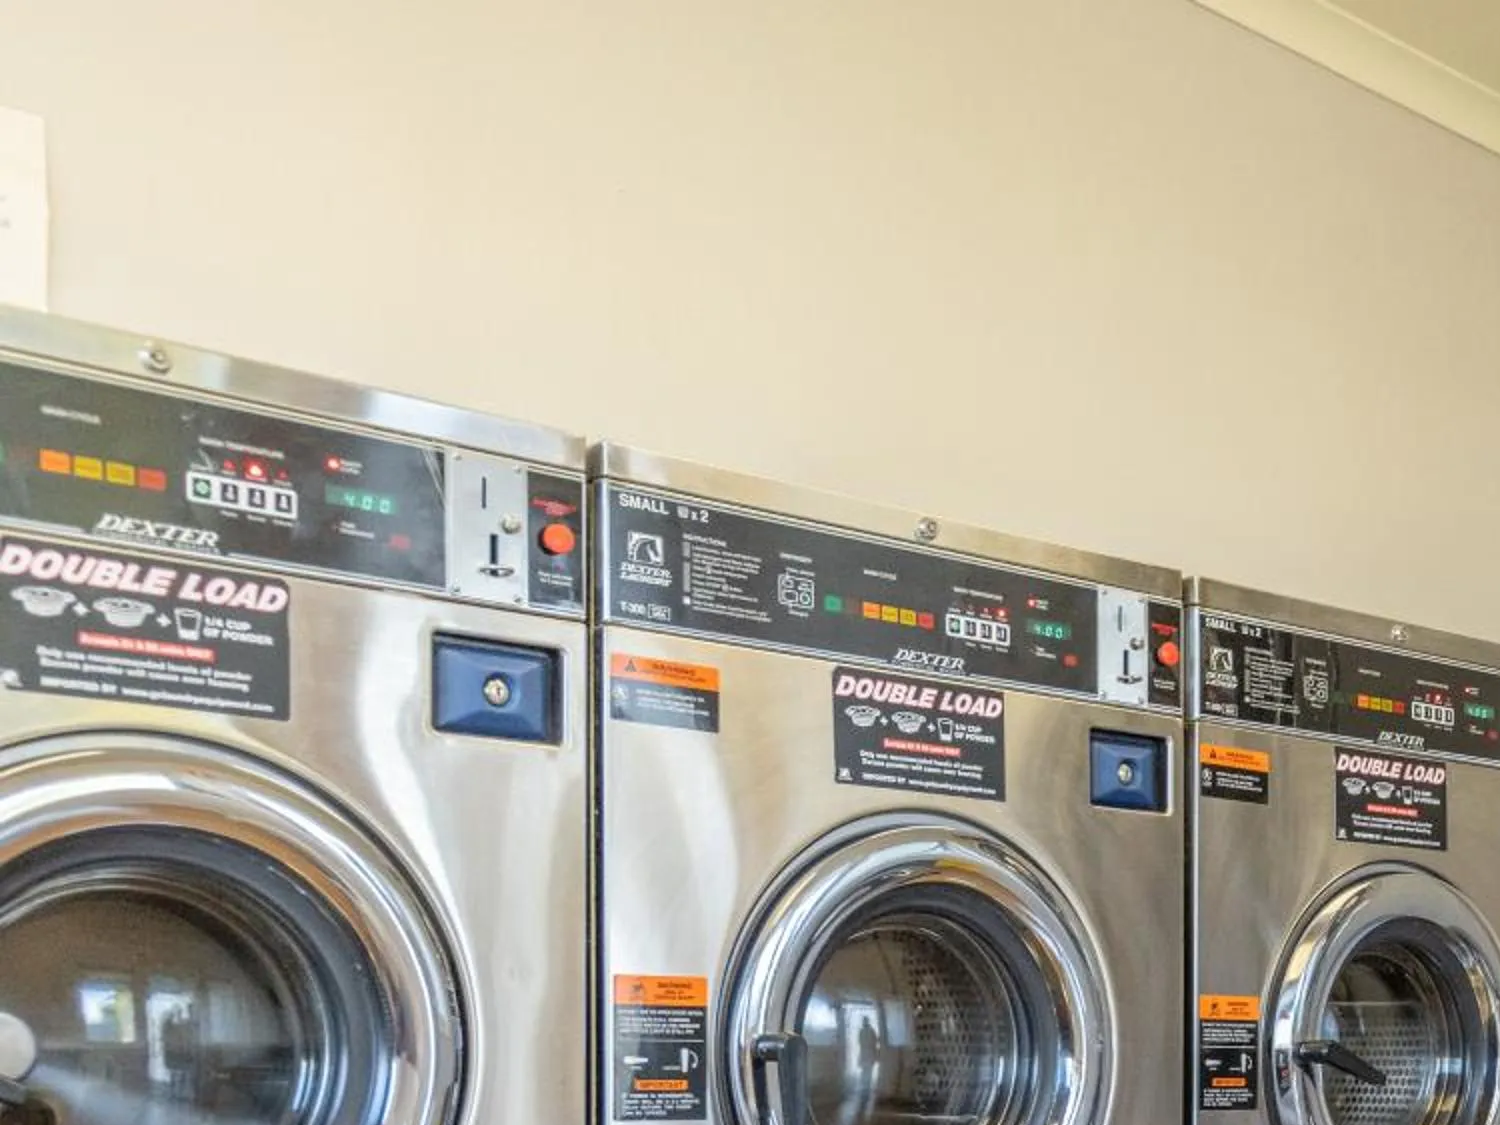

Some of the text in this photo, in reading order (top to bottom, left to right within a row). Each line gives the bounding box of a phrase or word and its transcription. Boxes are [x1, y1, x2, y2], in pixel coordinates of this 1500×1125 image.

[618, 493, 670, 517] SMALL
[700, 508, 710, 523] 2
[95, 512, 221, 547] DEXTER
[0, 544, 290, 614] DOUBLE LOAD
[1205, 616, 1237, 633] SMALL
[893, 647, 966, 673] DEXTER
[835, 675, 1003, 718] DOUBLE LOAD
[1336, 753, 1446, 785] DOUBLE LOAD
